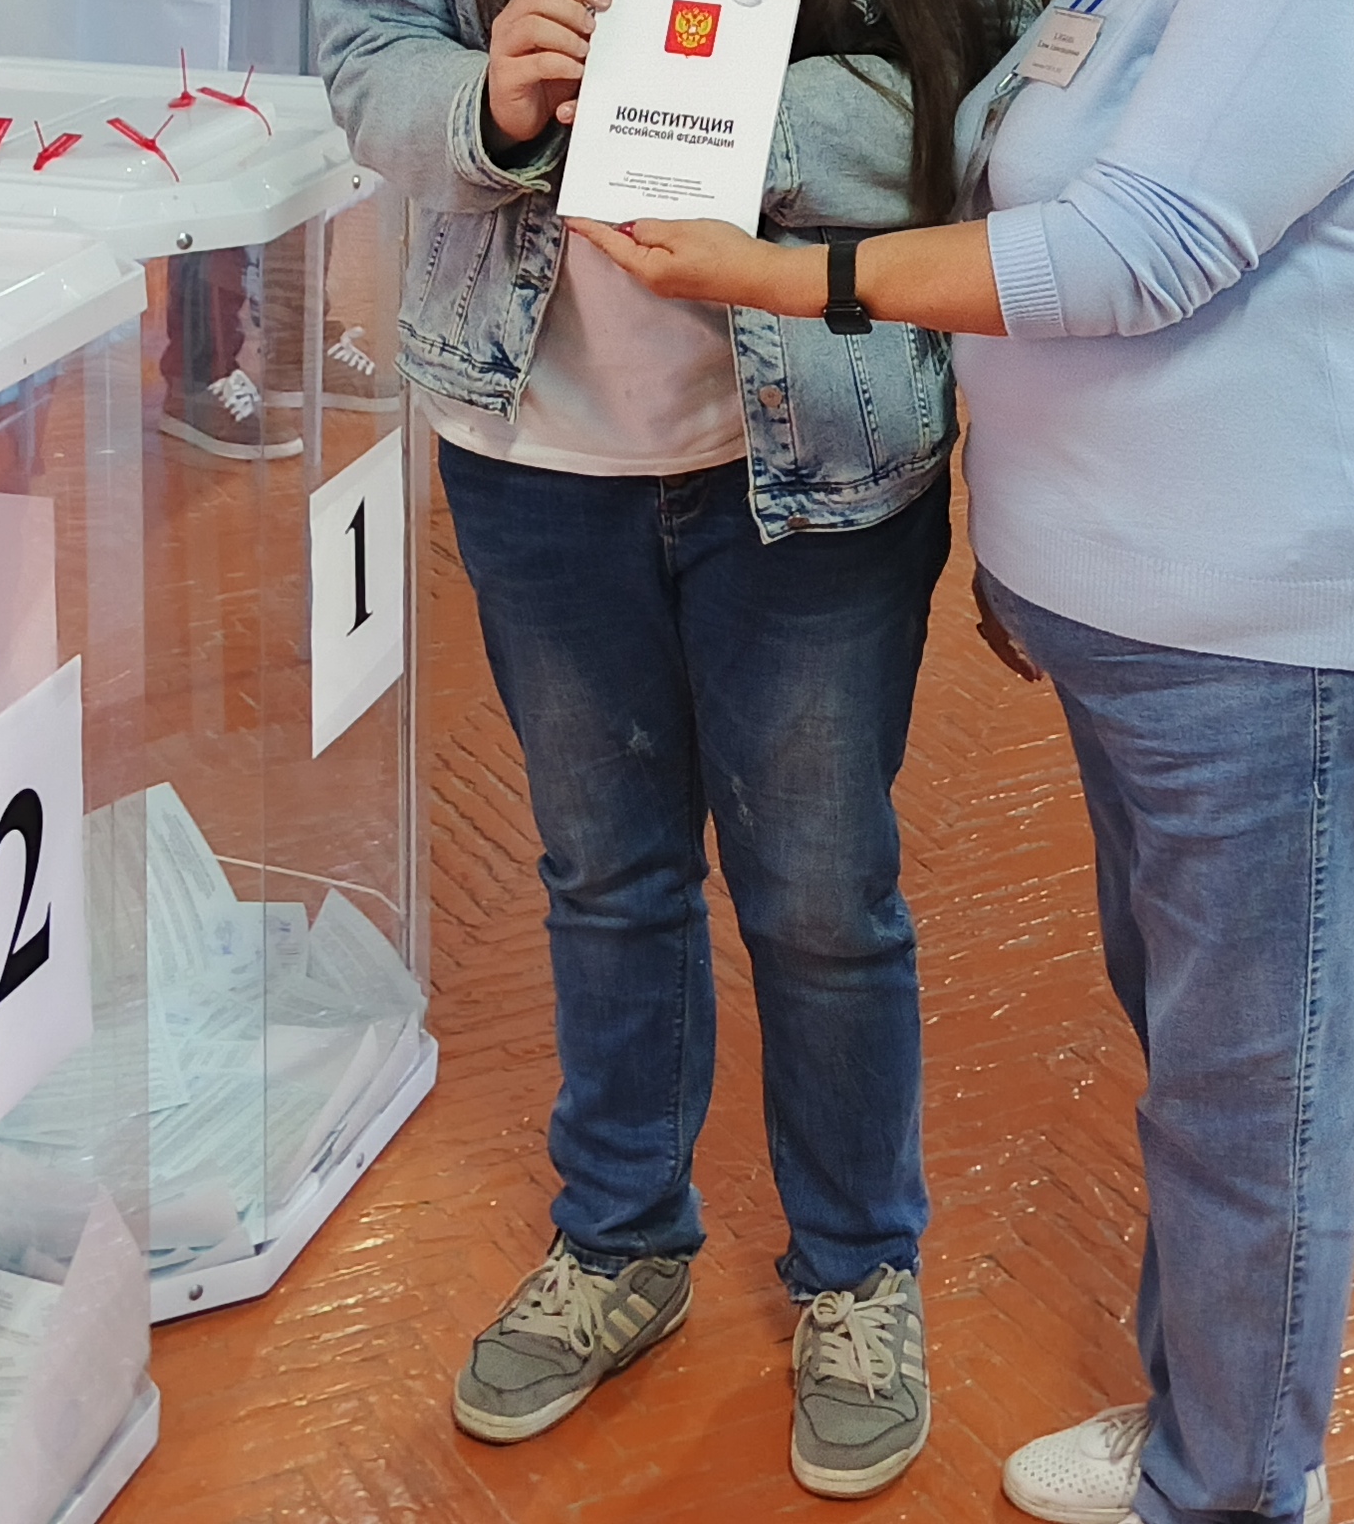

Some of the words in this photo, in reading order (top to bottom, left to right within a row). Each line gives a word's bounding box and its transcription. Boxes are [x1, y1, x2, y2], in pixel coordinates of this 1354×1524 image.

[615, 105, 735, 135] КОНСТИТУЦИЯ
[608, 124, 674, 141] РОССИЙСКОЙ
[676, 132, 735, 148] ФЕДЕРАЦИИ
[345, 496, 374, 637] 1
